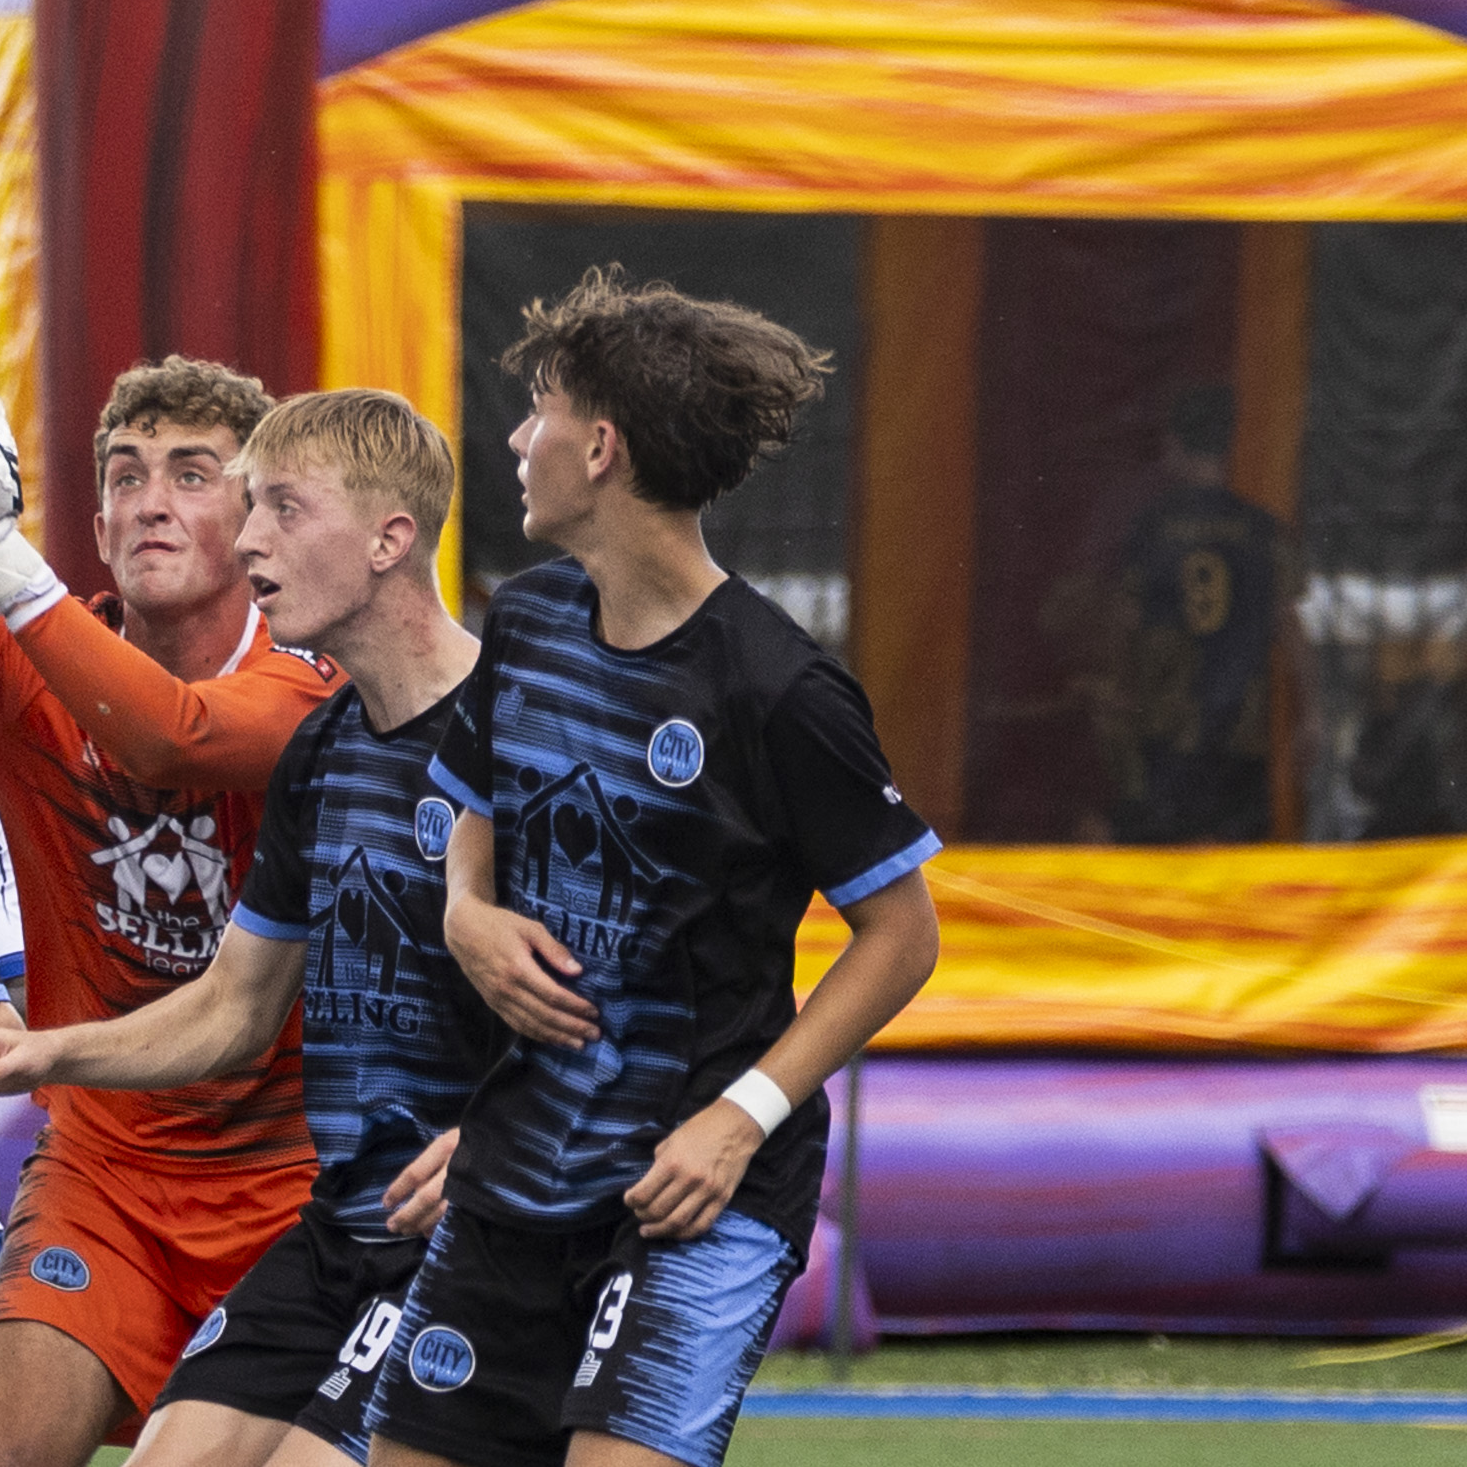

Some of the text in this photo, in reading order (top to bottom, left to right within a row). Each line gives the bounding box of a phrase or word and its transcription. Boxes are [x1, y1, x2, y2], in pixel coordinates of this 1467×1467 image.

[659, 733, 697, 764] CITY
[418, 807, 450, 840] CITY
[157, 909, 200, 932] the
[41, 1251, 82, 1277] CITY
[420, 1337, 467, 1371] CITY
